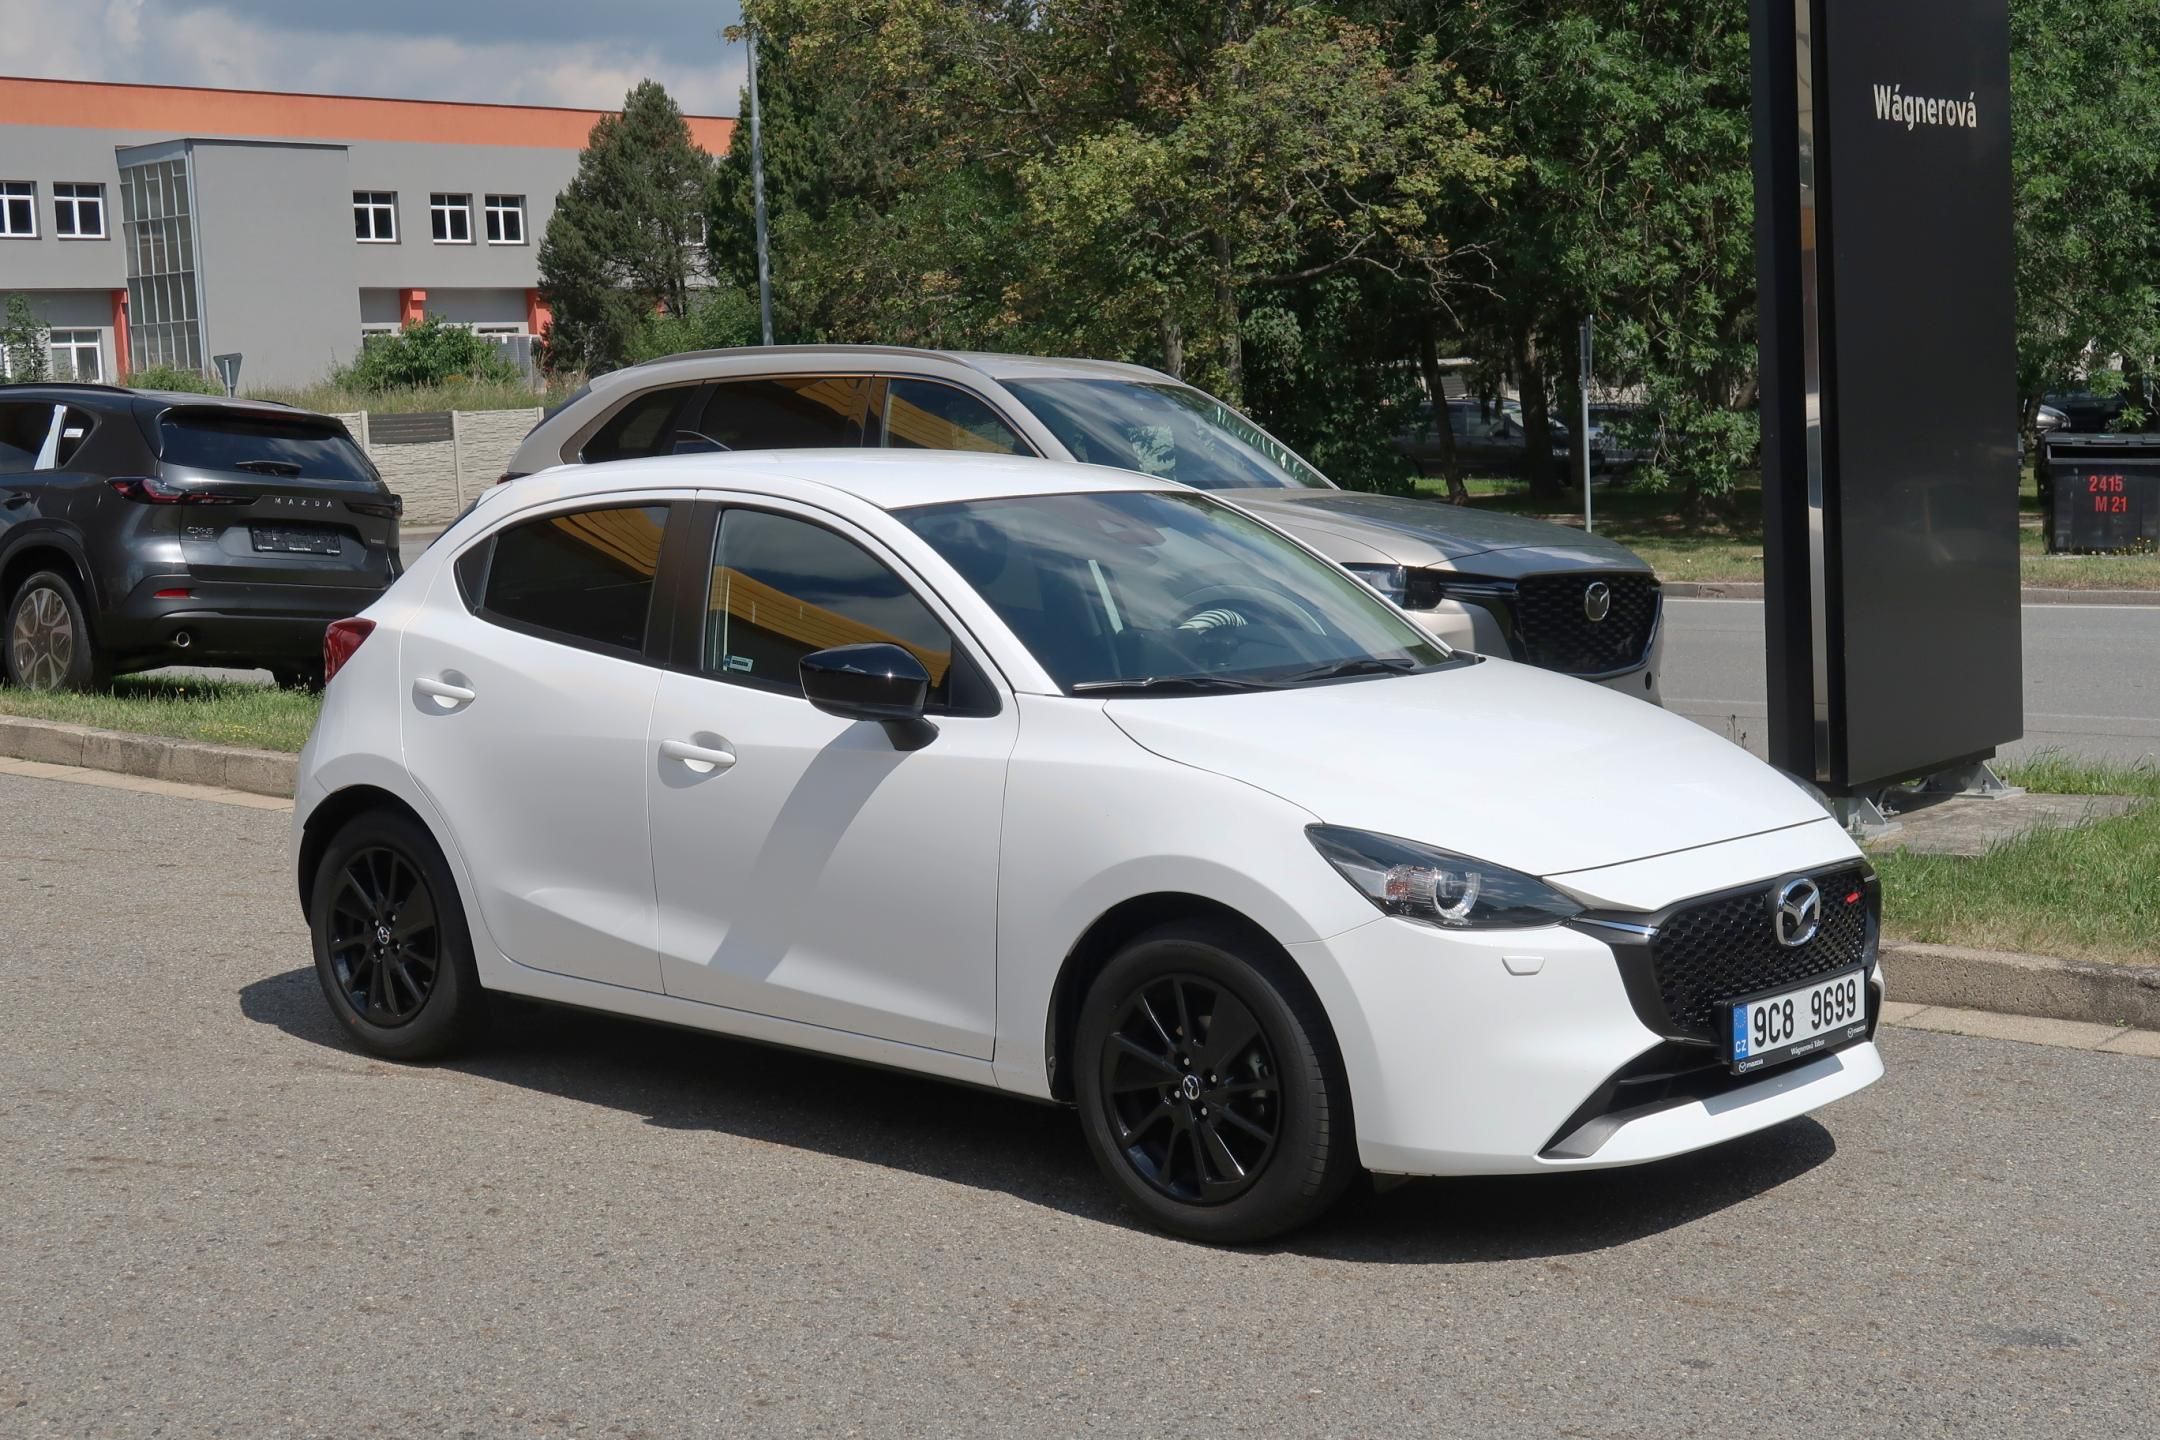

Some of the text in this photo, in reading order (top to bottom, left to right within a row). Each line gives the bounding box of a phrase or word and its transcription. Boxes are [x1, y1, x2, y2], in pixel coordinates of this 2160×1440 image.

[1873, 84, 1977, 131] Wágnerová
[2088, 474, 2124, 492] 2415
[275, 497, 333, 508] MAZDA
[2095, 496, 2128, 512] M 21
[1754, 979, 1856, 1047] 9C8 9699
[1735, 1040, 1747, 1053] CZ
